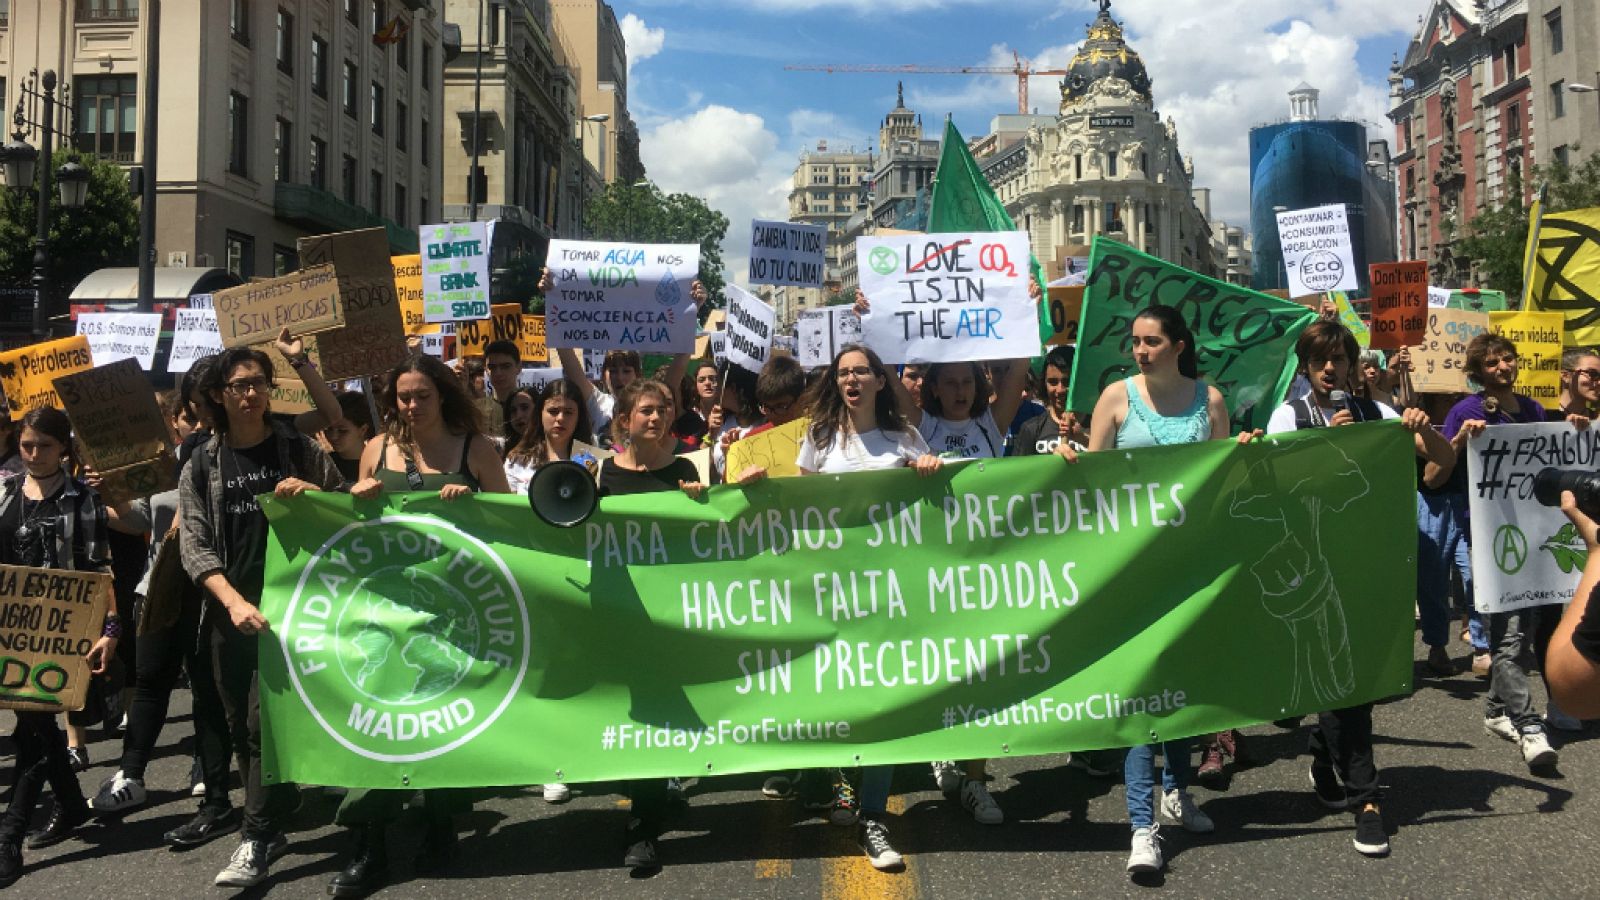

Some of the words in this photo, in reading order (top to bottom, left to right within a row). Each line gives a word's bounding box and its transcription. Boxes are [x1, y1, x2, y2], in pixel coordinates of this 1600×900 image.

[428, 239, 483, 259] CLIMATE
[752, 226, 788, 250] CAMBIA
[790, 229, 801, 251] TU
[561, 249, 600, 262] TOMAR
[603, 249, 646, 266] AGUA
[657, 254, 684, 266] NOS
[905, 239, 974, 274] LOVE
[1303, 260, 1340, 275] ECO
[440, 272, 480, 291] BANK
[561, 268, 579, 282] DA
[588, 266, 639, 288] VIDA
[750, 257, 767, 279] NO
[770, 258, 785, 280] TU
[787, 260, 821, 285] CLIMA!
[1305, 274, 1339, 284] CRISIS
[1374, 268, 1401, 285] Don't
[1404, 266, 1426, 284] wait
[560, 290, 606, 303] TOMAR
[898, 277, 943, 304] IS
[946, 276, 985, 302] IN
[1377, 291, 1400, 309] until
[1404, 290, 1420, 307] it's
[451, 301, 488, 317] SAVED
[1086, 254, 1298, 353] RECREOS
[492, 314, 523, 341] NO!
[557, 310, 668, 324] CONCIENCIA
[894, 308, 953, 341] THE
[956, 307, 1004, 340] AIR
[1374, 317, 1396, 333] too
[563, 329, 589, 341] NOS
[593, 329, 610, 341] DA
[619, 326, 671, 345] AGUA
[1510, 328, 1524, 343] tan
[20, 347, 91, 378] Petroleras
[1426, 358, 1435, 374] y
[1534, 352, 1559, 370] Tierra
[585, 520, 669, 568] PARA
[690, 506, 844, 560] CAMBIOS
[866, 501, 923, 548] SIN
[944, 482, 1187, 545] PRECEDENTES
[22, 572, 96, 605] ESPECIE
[680, 579, 793, 630] HACEN
[813, 568, 907, 622] FALTA
[928, 559, 1080, 614] MEDIDAS
[294, 537, 373, 676] FRIDAYS
[379, 529, 442, 560] FOR
[446, 548, 516, 671] FUTURE
[47, 607, 73, 633] DE
[735, 648, 792, 695] SIN
[814, 633, 1051, 693] PRECEDENTES
[346, 697, 476, 741] MADRID
[941, 689, 1187, 729] #YouthForClimate
[601, 717, 851, 753] #FridaysForFuture
